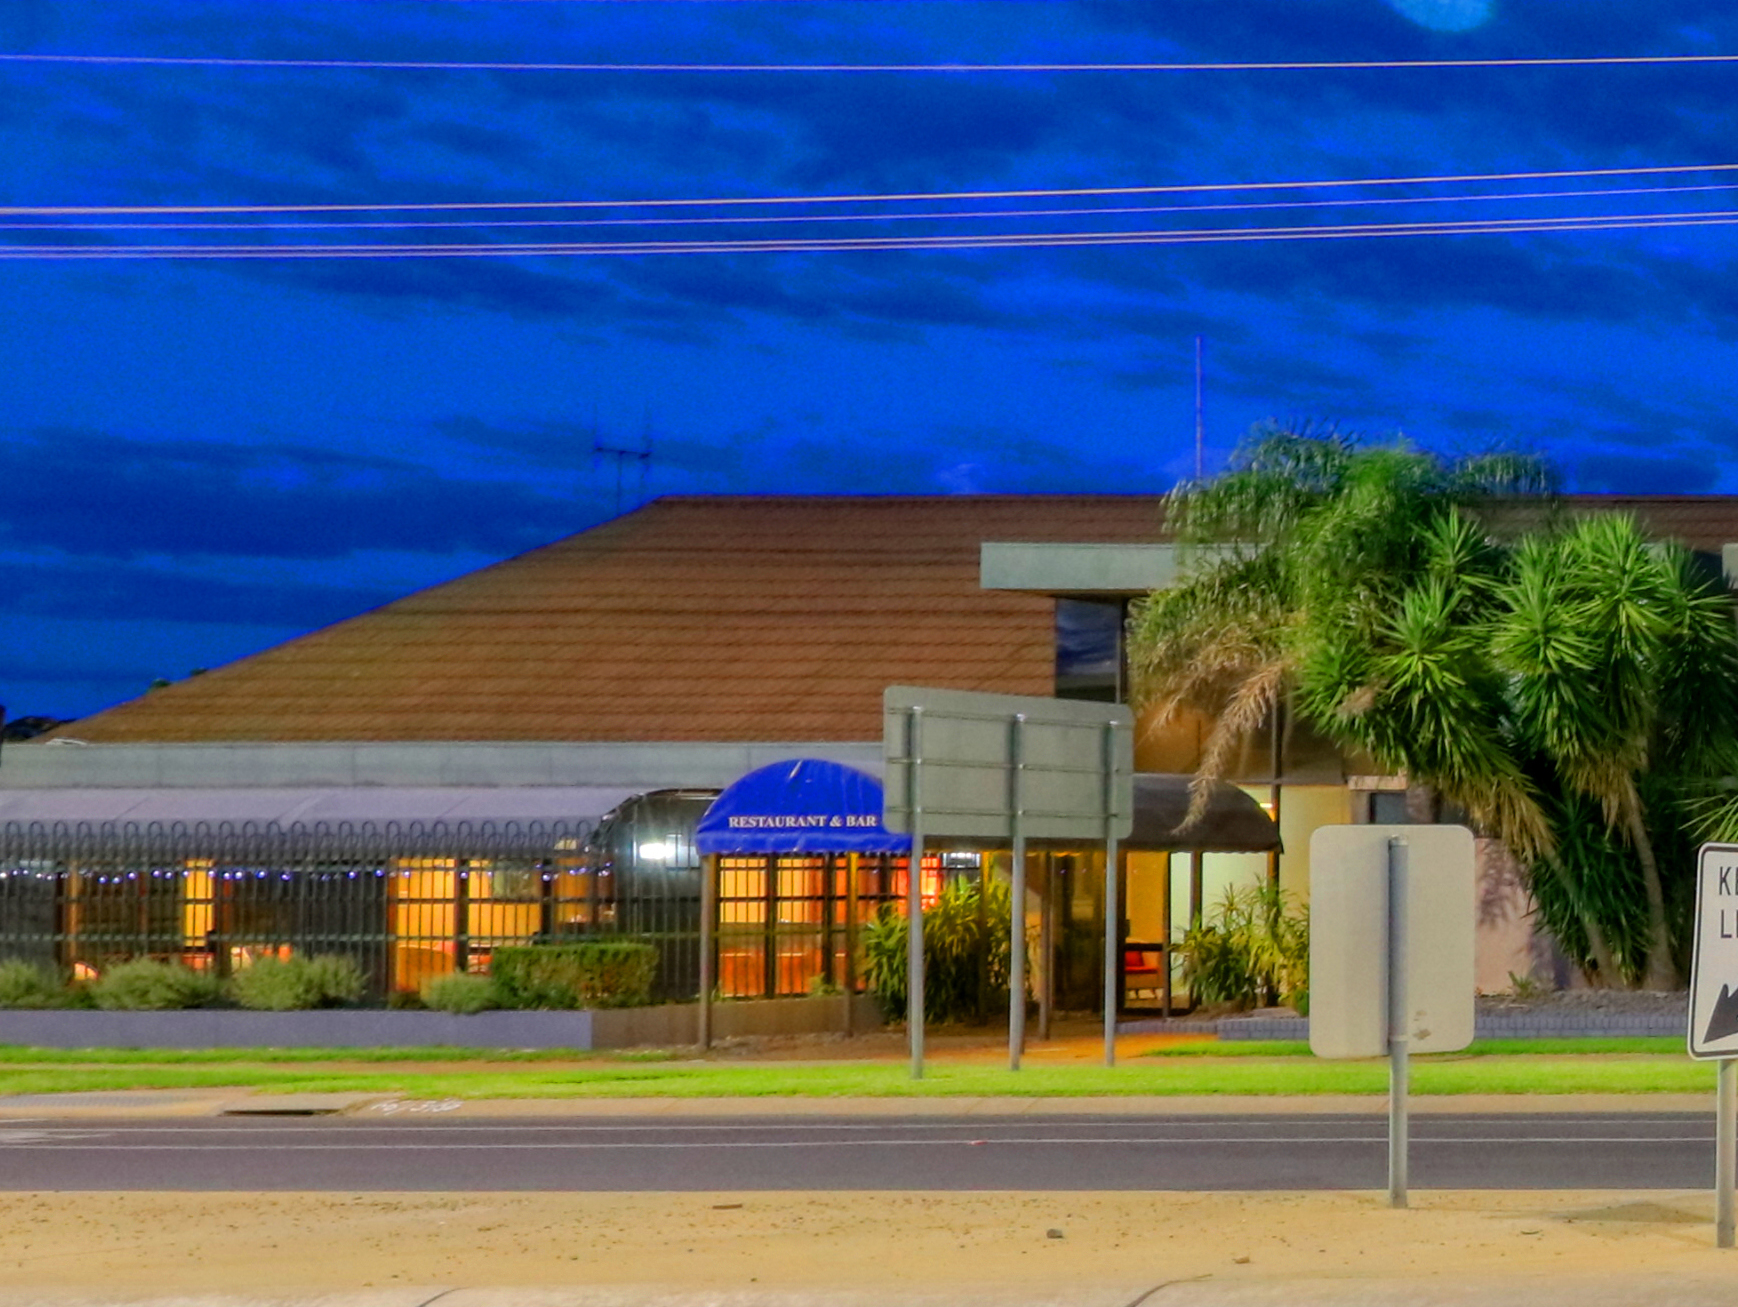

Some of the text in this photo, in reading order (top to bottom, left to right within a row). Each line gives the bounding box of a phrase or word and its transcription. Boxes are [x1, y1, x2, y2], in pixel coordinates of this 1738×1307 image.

[728, 815, 877, 828] RESTAURANT & BAR
